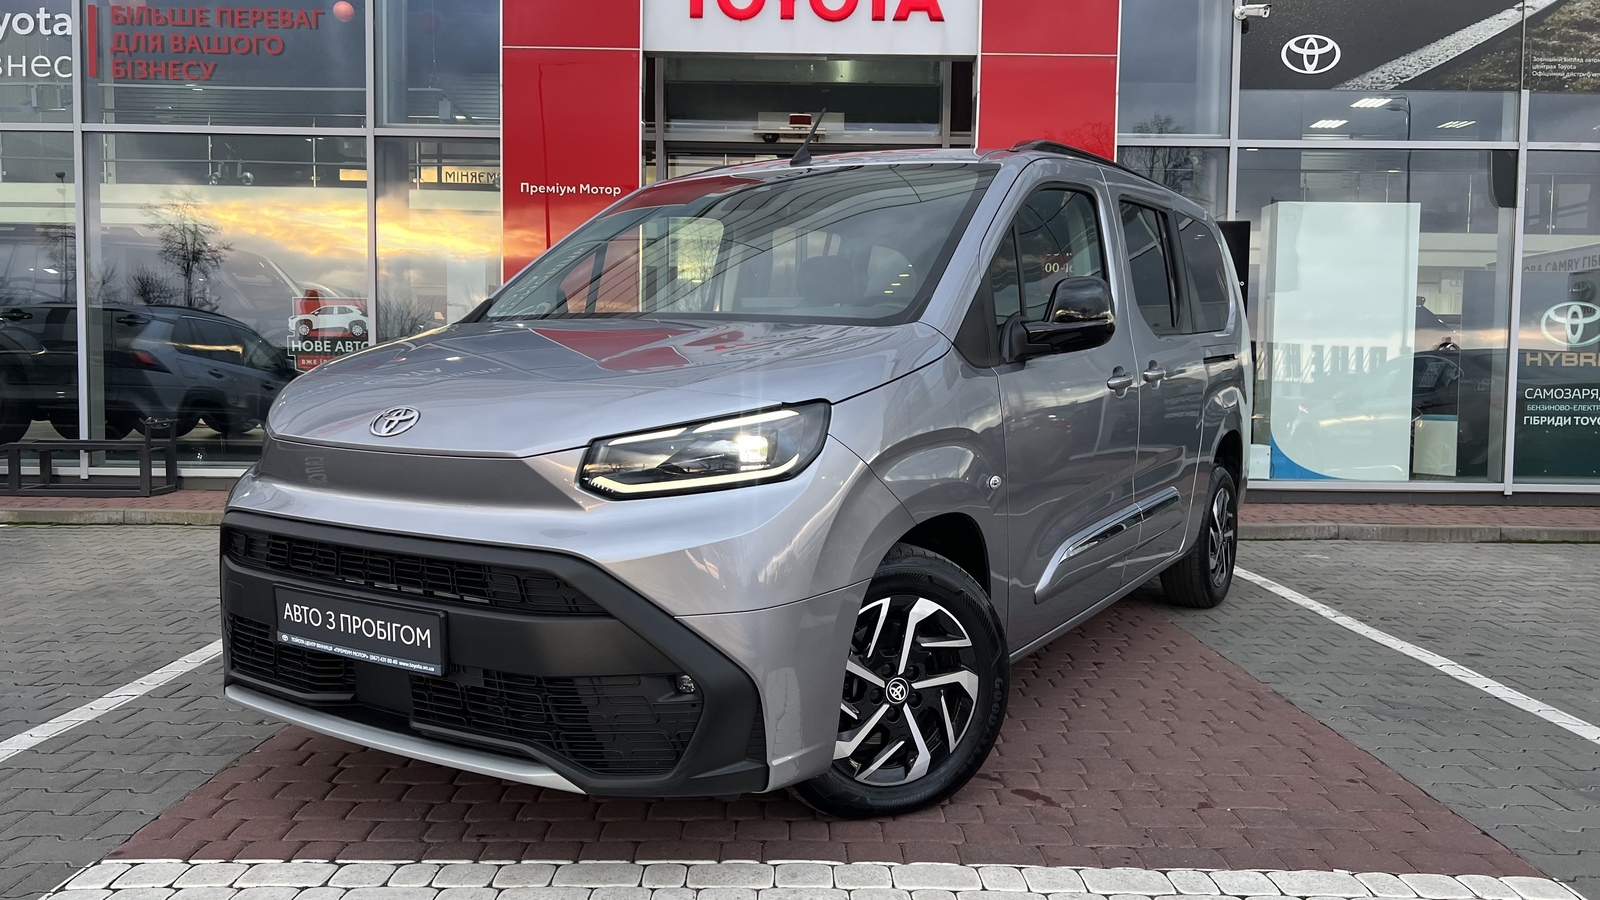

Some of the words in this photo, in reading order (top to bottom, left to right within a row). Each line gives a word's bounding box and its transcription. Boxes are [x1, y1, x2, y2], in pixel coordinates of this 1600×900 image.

[111, 5, 209, 26] БІЛЬШЕ
[216, 7, 324, 29] ПЕРЕВАГ
[110, 32, 162, 55] ДЛЯ
[170, 33, 284, 55] ВАШОГО
[0, 55, 72, 78] нес
[111, 59, 215, 80] БІЗНЕСУ
[520, 182, 576, 195] Преміум
[579, 184, 622, 196] Мотор
[1545, 257, 1580, 271] CAMRY
[1582, 254, 1600, 269] ГІБ
[291, 340, 331, 352] НОВЕ
[1524, 388, 1600, 401] САМОЗАРЯ
[1523, 416, 1572, 427] ГІБРИДИ
[283, 602, 322, 627] АВТО
[340, 613, 431, 648] ПРОБІГОМ
